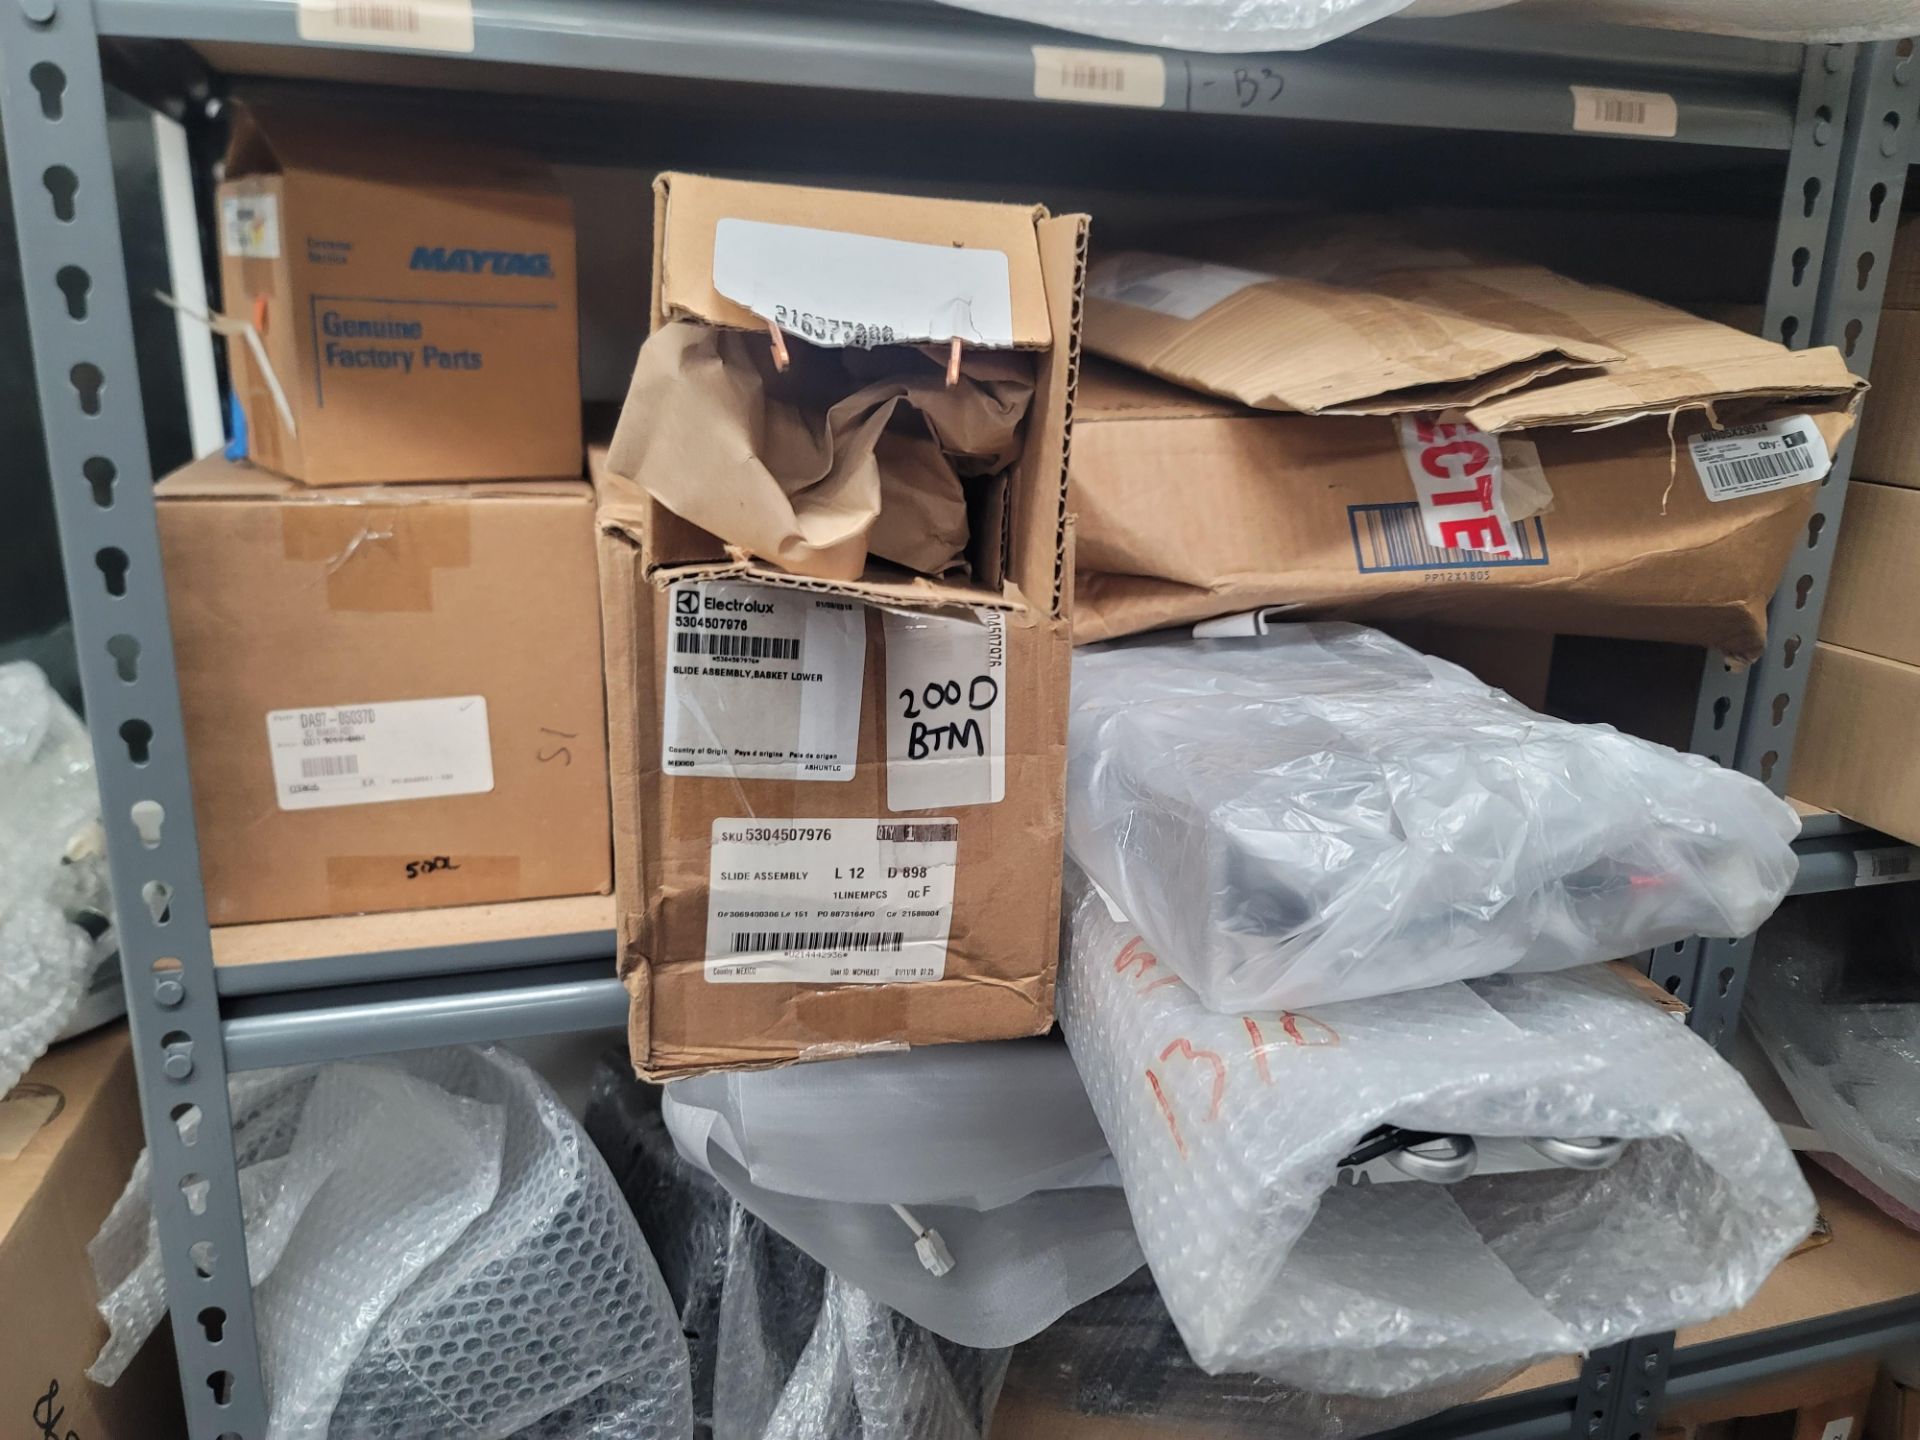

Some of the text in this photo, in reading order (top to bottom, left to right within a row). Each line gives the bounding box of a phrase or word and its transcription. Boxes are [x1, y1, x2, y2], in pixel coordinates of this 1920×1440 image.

[409, 246, 553, 278] MAYTAG
[322, 311, 422, 340] Genuine
[325, 343, 483, 373] Factory Parts
[1785, 437, 1793, 446] 1
[704, 597, 774, 614] Electrolux
[675, 616, 748, 631] 5304507976
[673, 666, 699, 675] SLIDE
[791, 672, 823, 682] LOWER
[908, 719, 984, 760] BTM
[706, 747, 728, 756] Origin
[722, 828, 832, 842] SKU 5304507976
[877, 825, 915, 841] QTY 1
[720, 871, 809, 881] SLIDE ASSEMBLY
[835, 867, 865, 879] L 12
[888, 866, 928, 878] D 898
[923, 886, 931, 897] F
